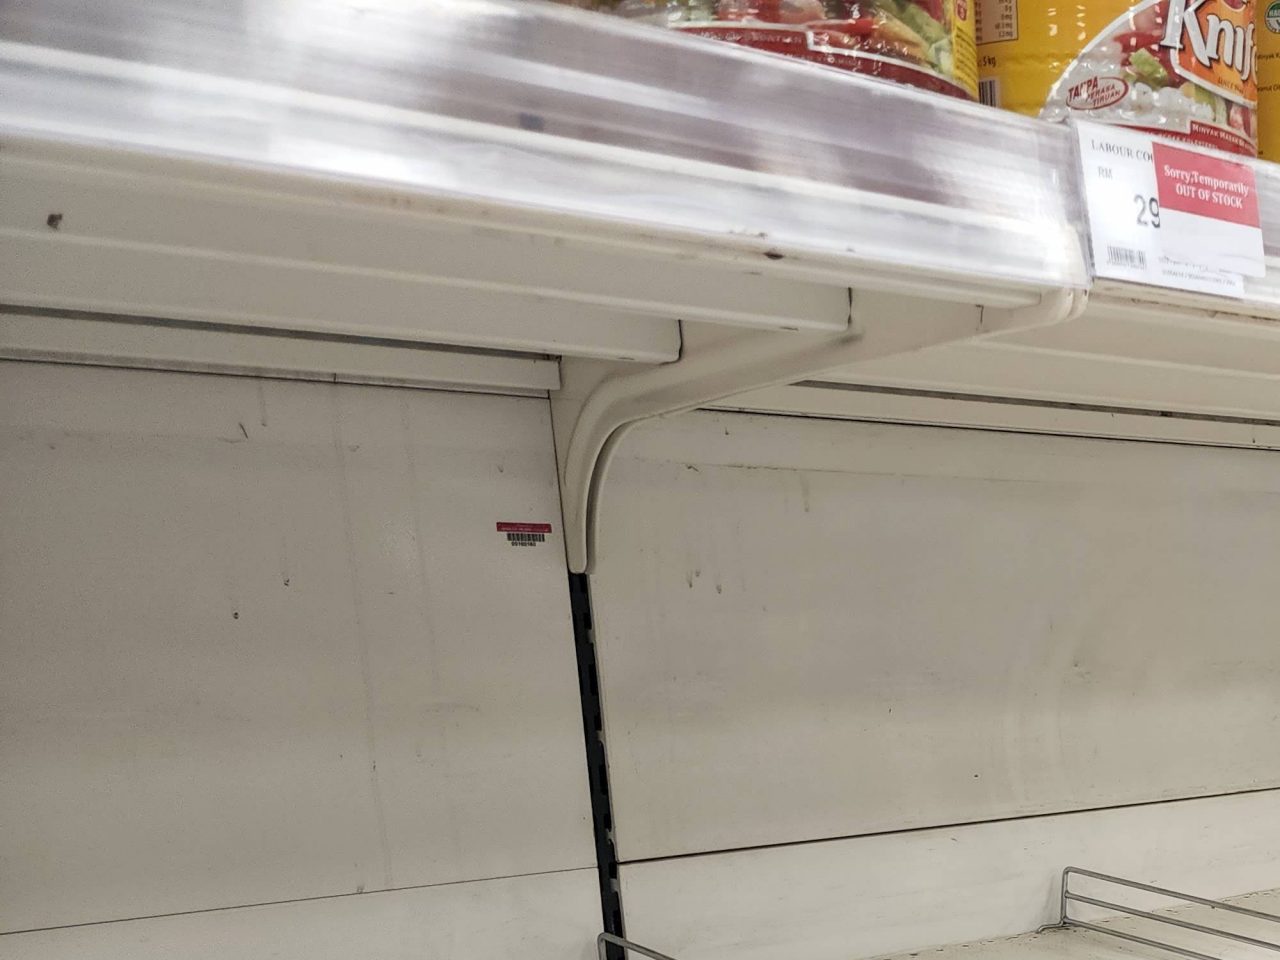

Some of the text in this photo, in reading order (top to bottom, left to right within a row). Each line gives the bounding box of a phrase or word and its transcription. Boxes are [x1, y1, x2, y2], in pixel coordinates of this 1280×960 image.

[1091, 140, 1134, 159] LABOUR
[1175, 183, 1243, 209] OUT OF STOCK
